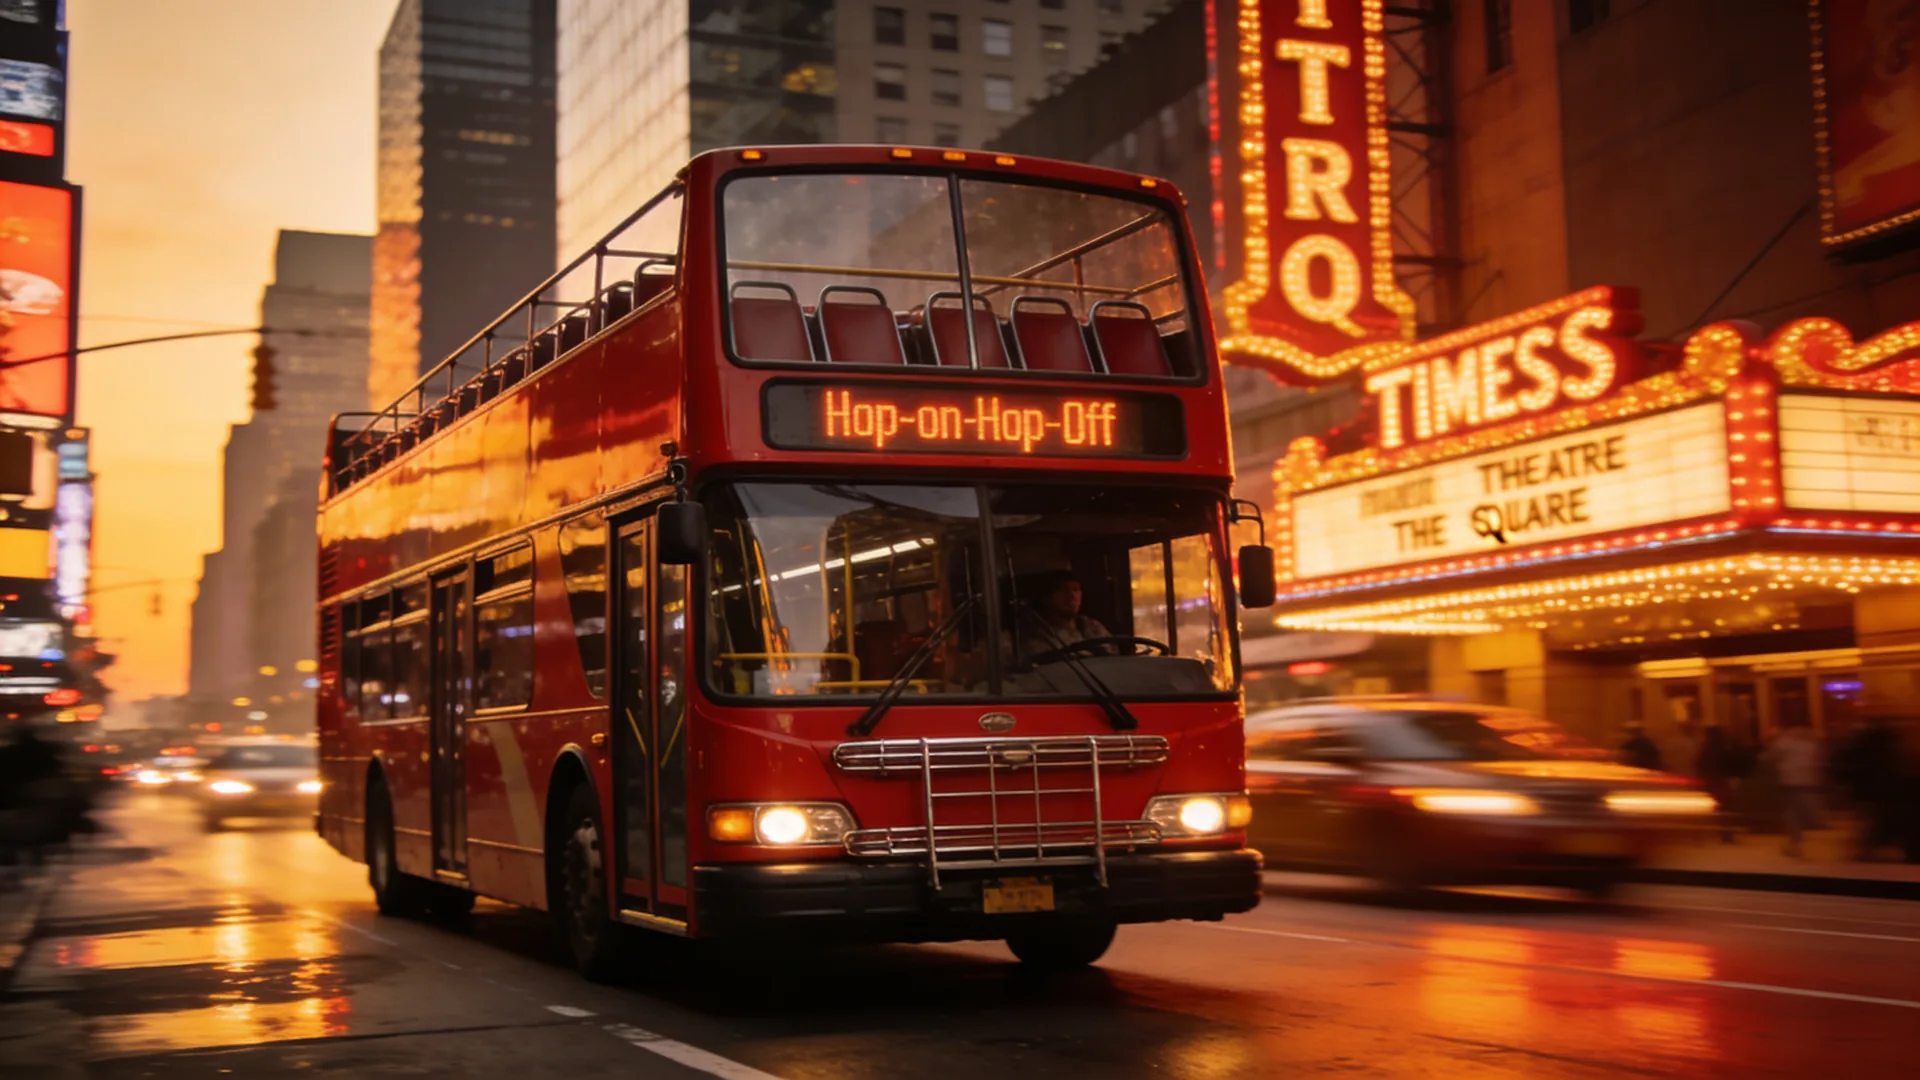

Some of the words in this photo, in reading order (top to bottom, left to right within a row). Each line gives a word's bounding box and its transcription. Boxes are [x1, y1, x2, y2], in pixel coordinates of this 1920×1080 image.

[1365, 306, 1616, 447] TIMESS
[824, 390, 1117, 452] Hop-on-Hop-Off
[1477, 435, 1625, 494] THEATRE
[1392, 514, 1447, 550] THE
